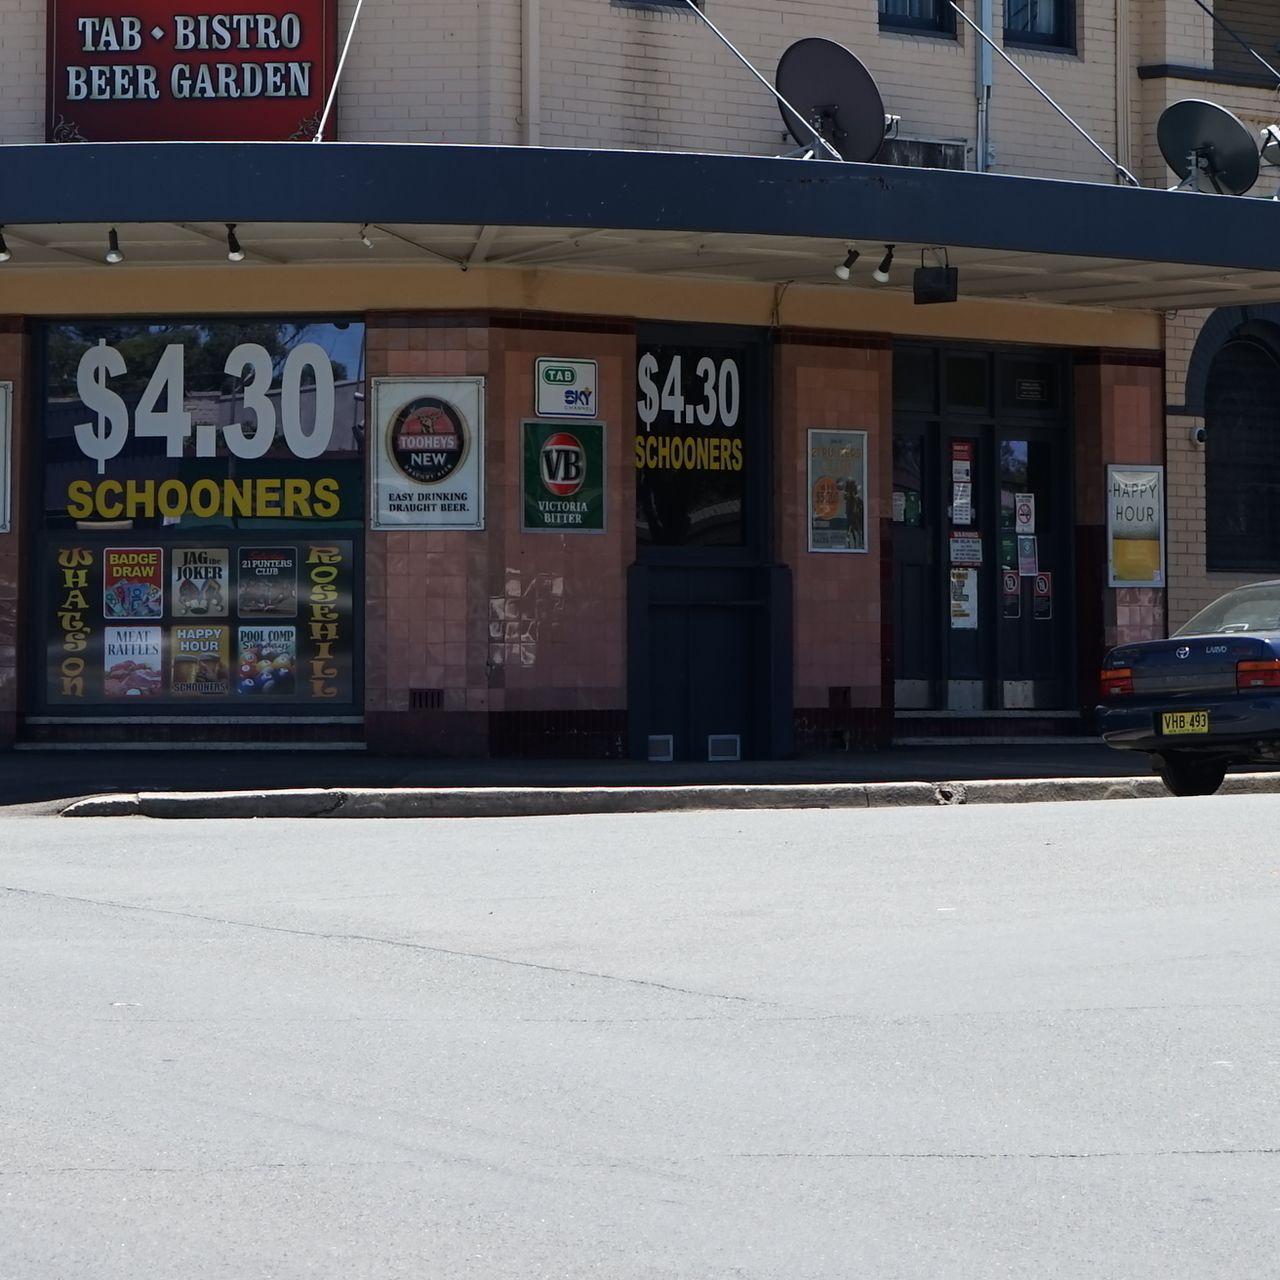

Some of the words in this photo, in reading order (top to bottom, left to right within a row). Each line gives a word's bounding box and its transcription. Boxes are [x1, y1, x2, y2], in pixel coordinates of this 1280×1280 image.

[78, 16, 143, 52] TAB
[174, 13, 301, 51] BISTRO
[66, 65, 160, 101] BEER
[171, 61, 312, 99] GARDEN
[548, 370, 572, 382] TAB
[564, 388, 593, 406] SKY
[637, 351, 740, 432] $4.30
[73, 338, 336, 474] $4.30
[399, 435, 455, 448] TOOHEYS
[411, 452, 447, 466] NEW
[634, 435, 743, 471] SCHOONERS
[543, 447, 581, 482] VB
[388, 492, 414, 502] EASY
[417, 492, 468, 502] DRINKING
[1113, 483, 1157, 499] HAPPY
[66, 478, 341, 519] SCHOONERS
[388, 503, 439, 513] DRAUGHT
[440, 502, 470, 512] BEER.
[538, 500, 588, 512] VICTORIA
[544, 512, 583, 524] BITTER
[1115, 506, 1155, 522] HOUR
[109, 553, 158, 565] BADGE
[183, 551, 208, 566] JAG
[241, 560, 251, 568] 21
[252, 559, 293, 568] PUNTERS
[112, 566, 155, 577] DRAW
[176, 565, 223, 582] JOKER
[255, 567, 279, 576] CLUB
[305, 545, 343, 698] ROSEHILL
[116, 631, 152, 642] MEAT
[176, 629, 222, 640] HAPPY
[240, 630, 266, 642] POOL
[267, 630, 294, 642] COMP
[107, 643, 159, 656] RAFFLES
[180, 641, 219, 652] HOUR
[174, 682, 225, 692] SCHOONERS
